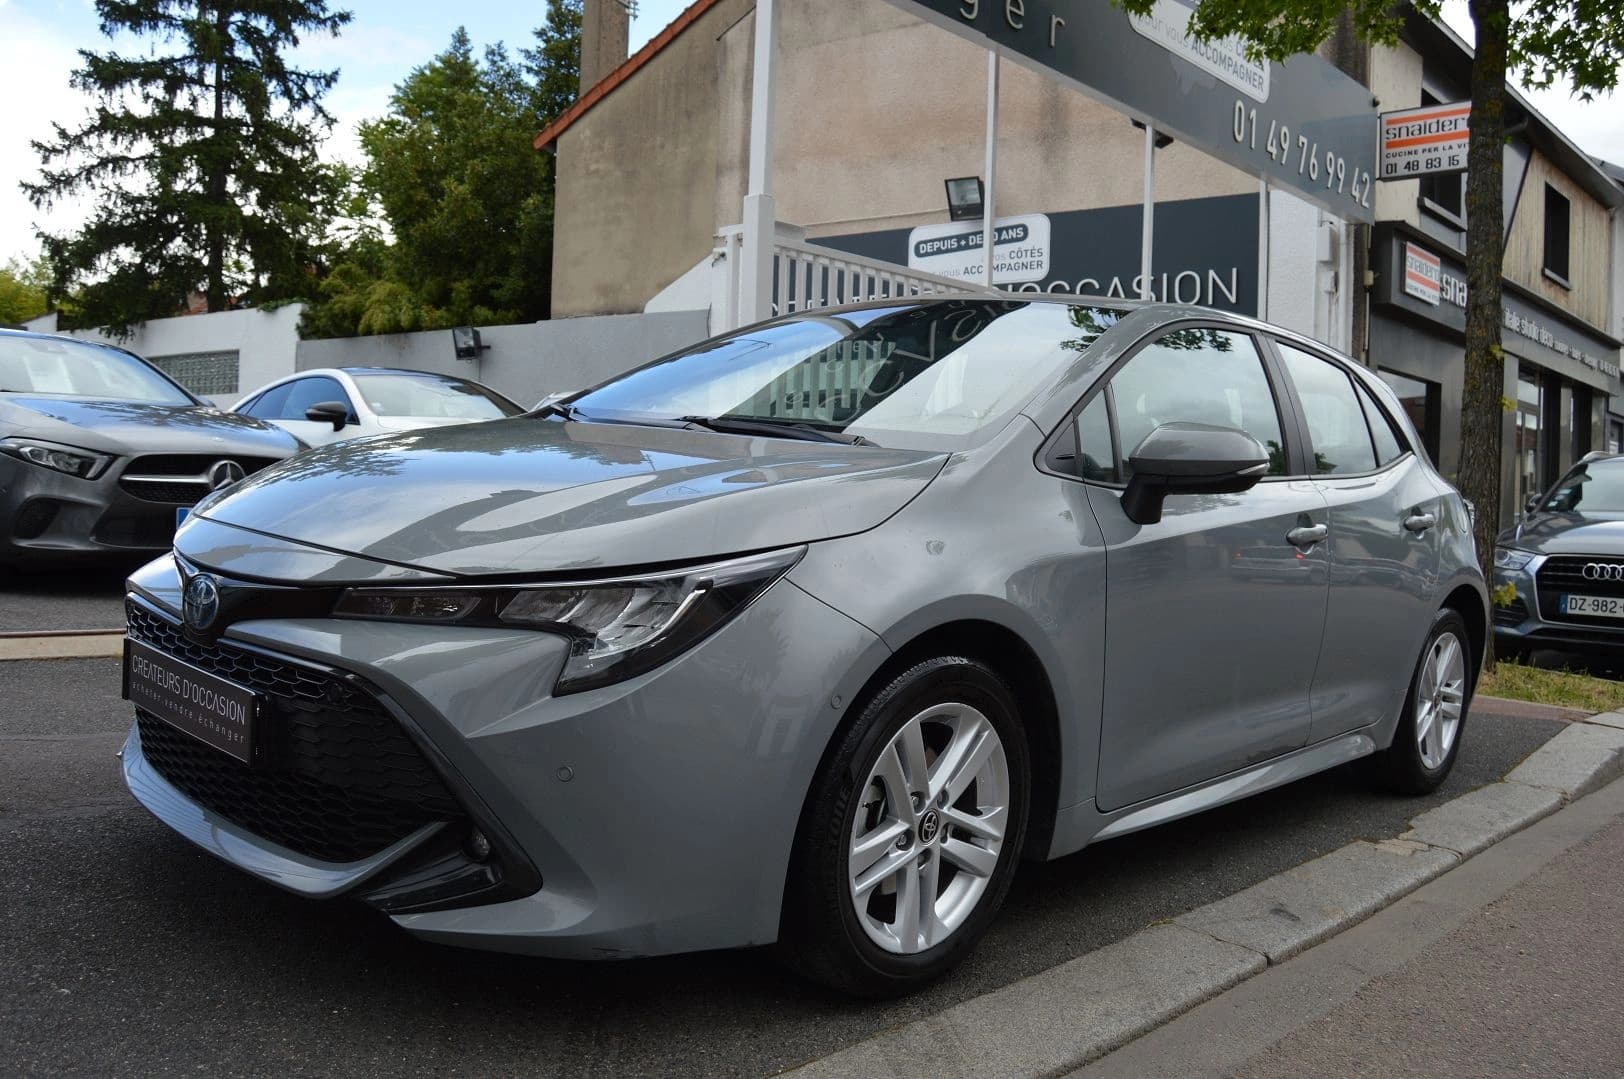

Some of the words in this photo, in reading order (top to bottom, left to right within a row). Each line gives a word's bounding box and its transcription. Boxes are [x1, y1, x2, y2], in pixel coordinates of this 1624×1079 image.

[1191, 38, 1264, 93] ACCOMPAGNER
[1385, 117, 1467, 140] snaider
[1234, 99, 1257, 150] 01
[1267, 119, 1290, 166] 49
[1298, 134, 1319, 181] 76
[1326, 151, 1346, 195] 99
[1351, 166, 1371, 209] 42
[1385, 149, 1419, 159] CUCINE
[1385, 162, 1398, 175] 01
[1403, 160, 1420, 172] 48
[1425, 157, 1442, 170] 83
[1447, 154, 1461, 167] 15
[919, 238, 958, 254] DEPUIS
[968, 233, 983, 246] DE
[1000, 227, 1025, 240] ANS
[1008, 246, 1044, 261] CÔTÉS
[962, 259, 1044, 277] ACCMPAGNER
[1442, 272, 1468, 308] sna
[1569, 594, 1624, 614] DZ-982-
[132, 655, 181, 695] CREATEURS
[182, 679, 246, 726] D'OCCASION
